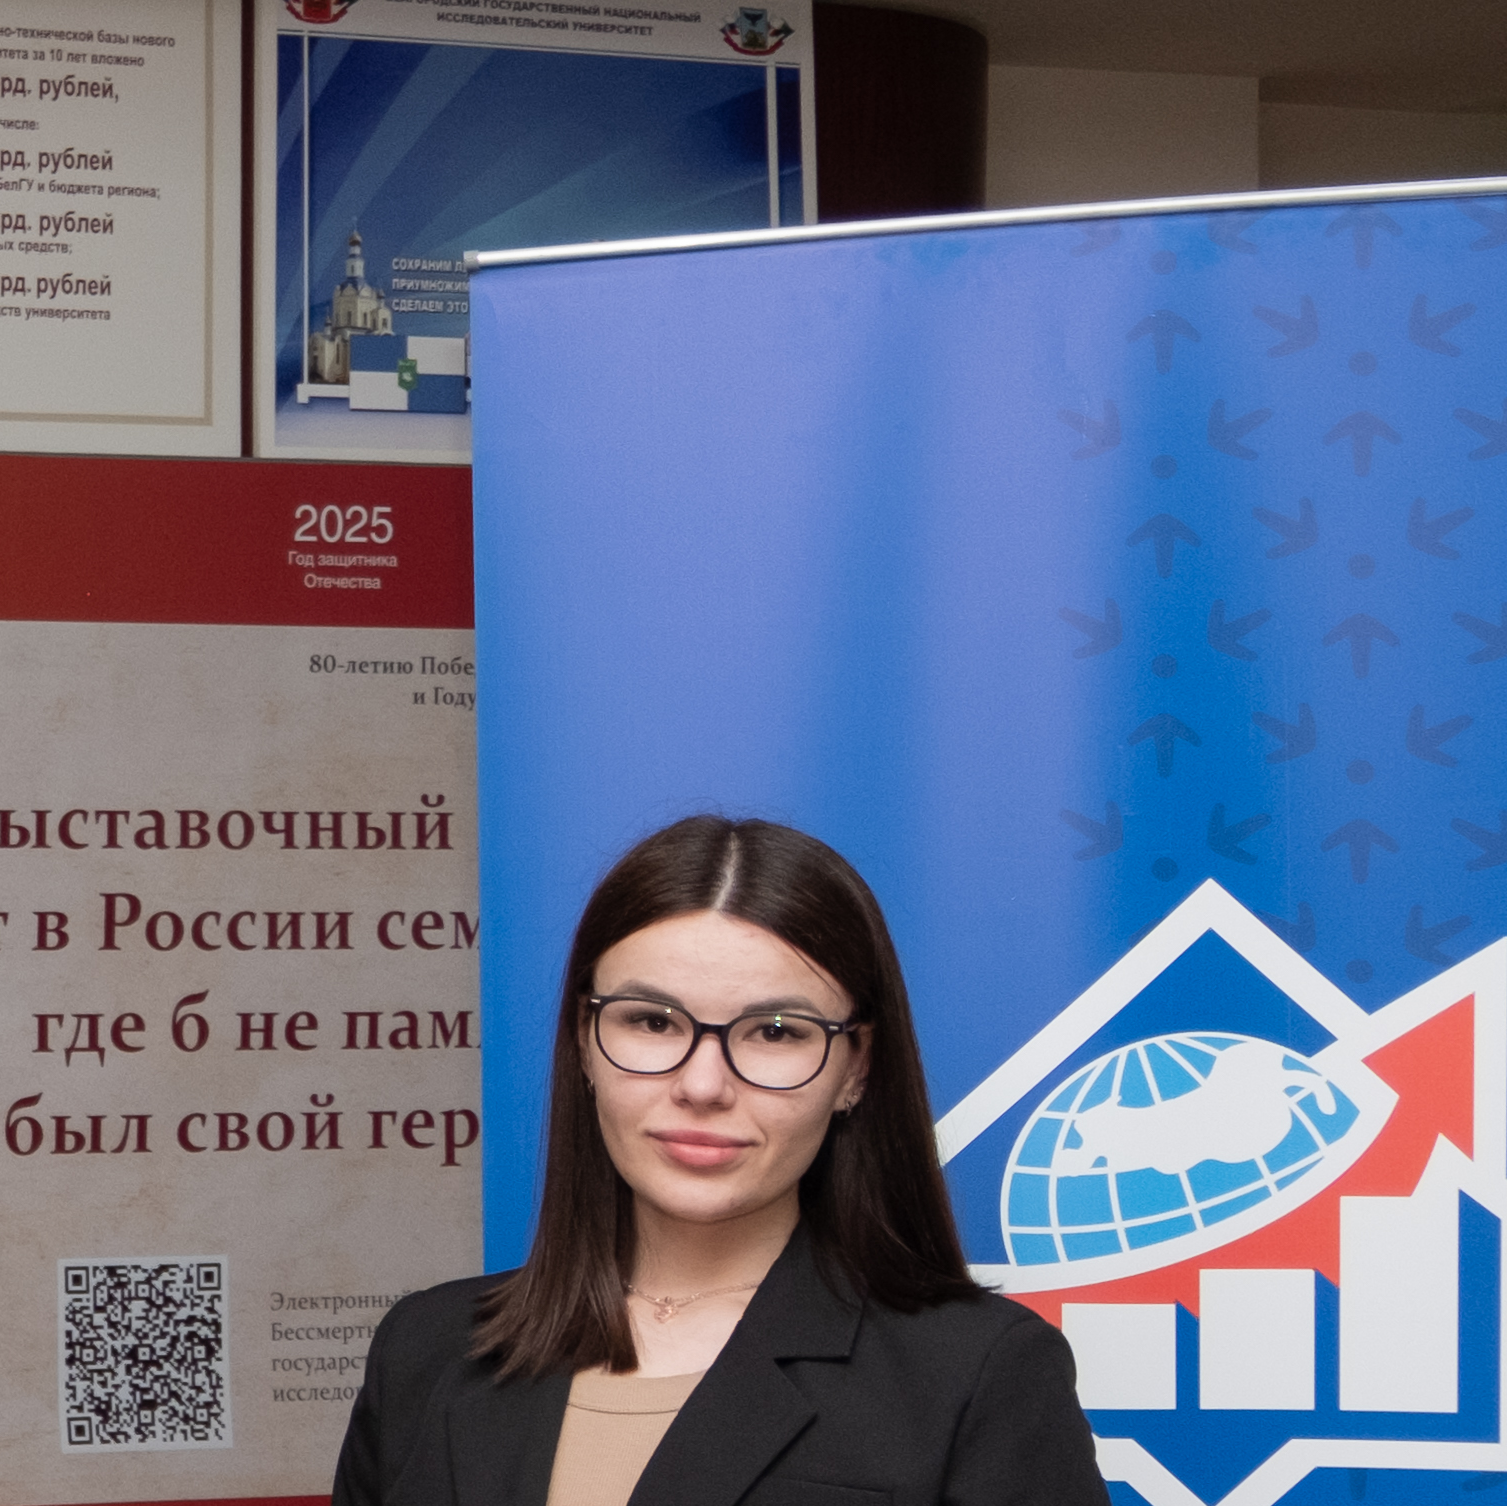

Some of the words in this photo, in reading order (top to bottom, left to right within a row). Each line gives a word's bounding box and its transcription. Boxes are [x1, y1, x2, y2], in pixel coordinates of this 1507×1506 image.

[437, 12, 569, 30] ИССЛЕДОВАТЕЛЬСКИЙ
[572, 22, 654, 36] УНИВЕРСИТЕТ
[603, 7, 702, 23] НАЦИОНАЛЬНЫЙ
[97, 29, 130, 46] базы
[132, 35, 175, 48] нового
[32, 51, 46, 61] за
[50, 49, 64, 62] 10
[67, 52, 88, 64] лет
[91, 54, 145, 68] вложено
[39, 75, 119, 103] рублей,
[0, 119, 40, 131] числе:
[38, 148, 114, 174] рублей
[38, 183, 45, 193] и
[49, 181, 104, 197] бюджета
[39, 212, 114, 238] рублей
[392, 257, 452, 272] СОХРАНИМ
[37, 274, 112, 300] рублей
[25, 305, 111, 322] университета
[391, 298, 444, 313] СДЕЛАЕМ
[446, 301, 469, 314] ЭТО
[293, 504, 394, 544] 2025
[288, 551, 315, 568] Год
[317, 552, 399, 568] защитника
[303, 573, 382, 590] Отечества
[309, 654, 414, 675] 80-летию
[421, 656, 475, 676] Побе
[412, 690, 426, 706] и
[32, 912, 70, 950] в
[98, 892, 355, 951] России
[376, 909, 480, 951] сем
[32, 1010, 147, 1067] где
[171, 989, 211, 1053] б
[235, 1010, 319, 1052] не
[341, 1008, 481, 1051] пам
[4, 1092, 153, 1156] был
[176, 1094, 344, 1153] свой
[367, 1107, 480, 1167] гер
[271, 1323, 377, 1344] Бессмертн
[273, 1386, 360, 1402] исследо
